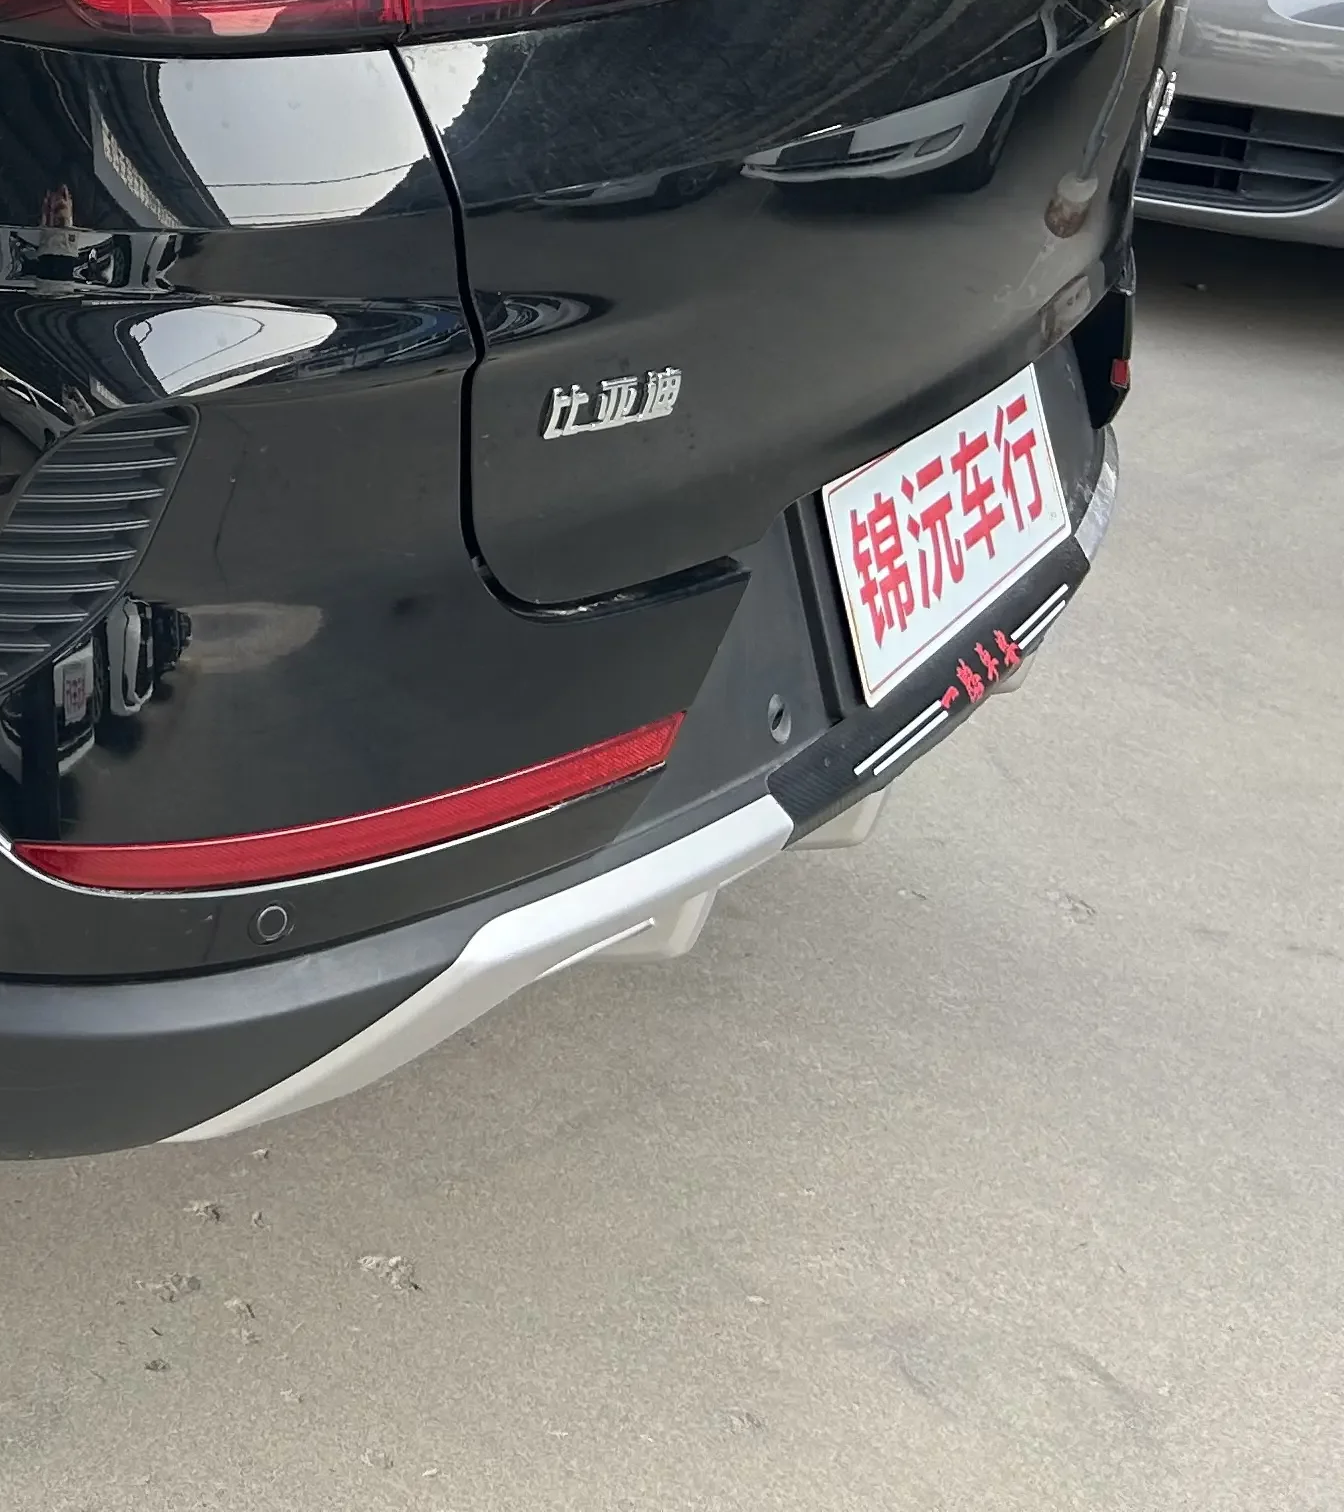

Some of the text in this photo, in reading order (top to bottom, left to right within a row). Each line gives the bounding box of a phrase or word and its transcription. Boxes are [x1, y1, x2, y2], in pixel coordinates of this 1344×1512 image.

[541, 367, 682, 440] 比亚迪
[849, 394, 1043, 648] 锦沅车行
